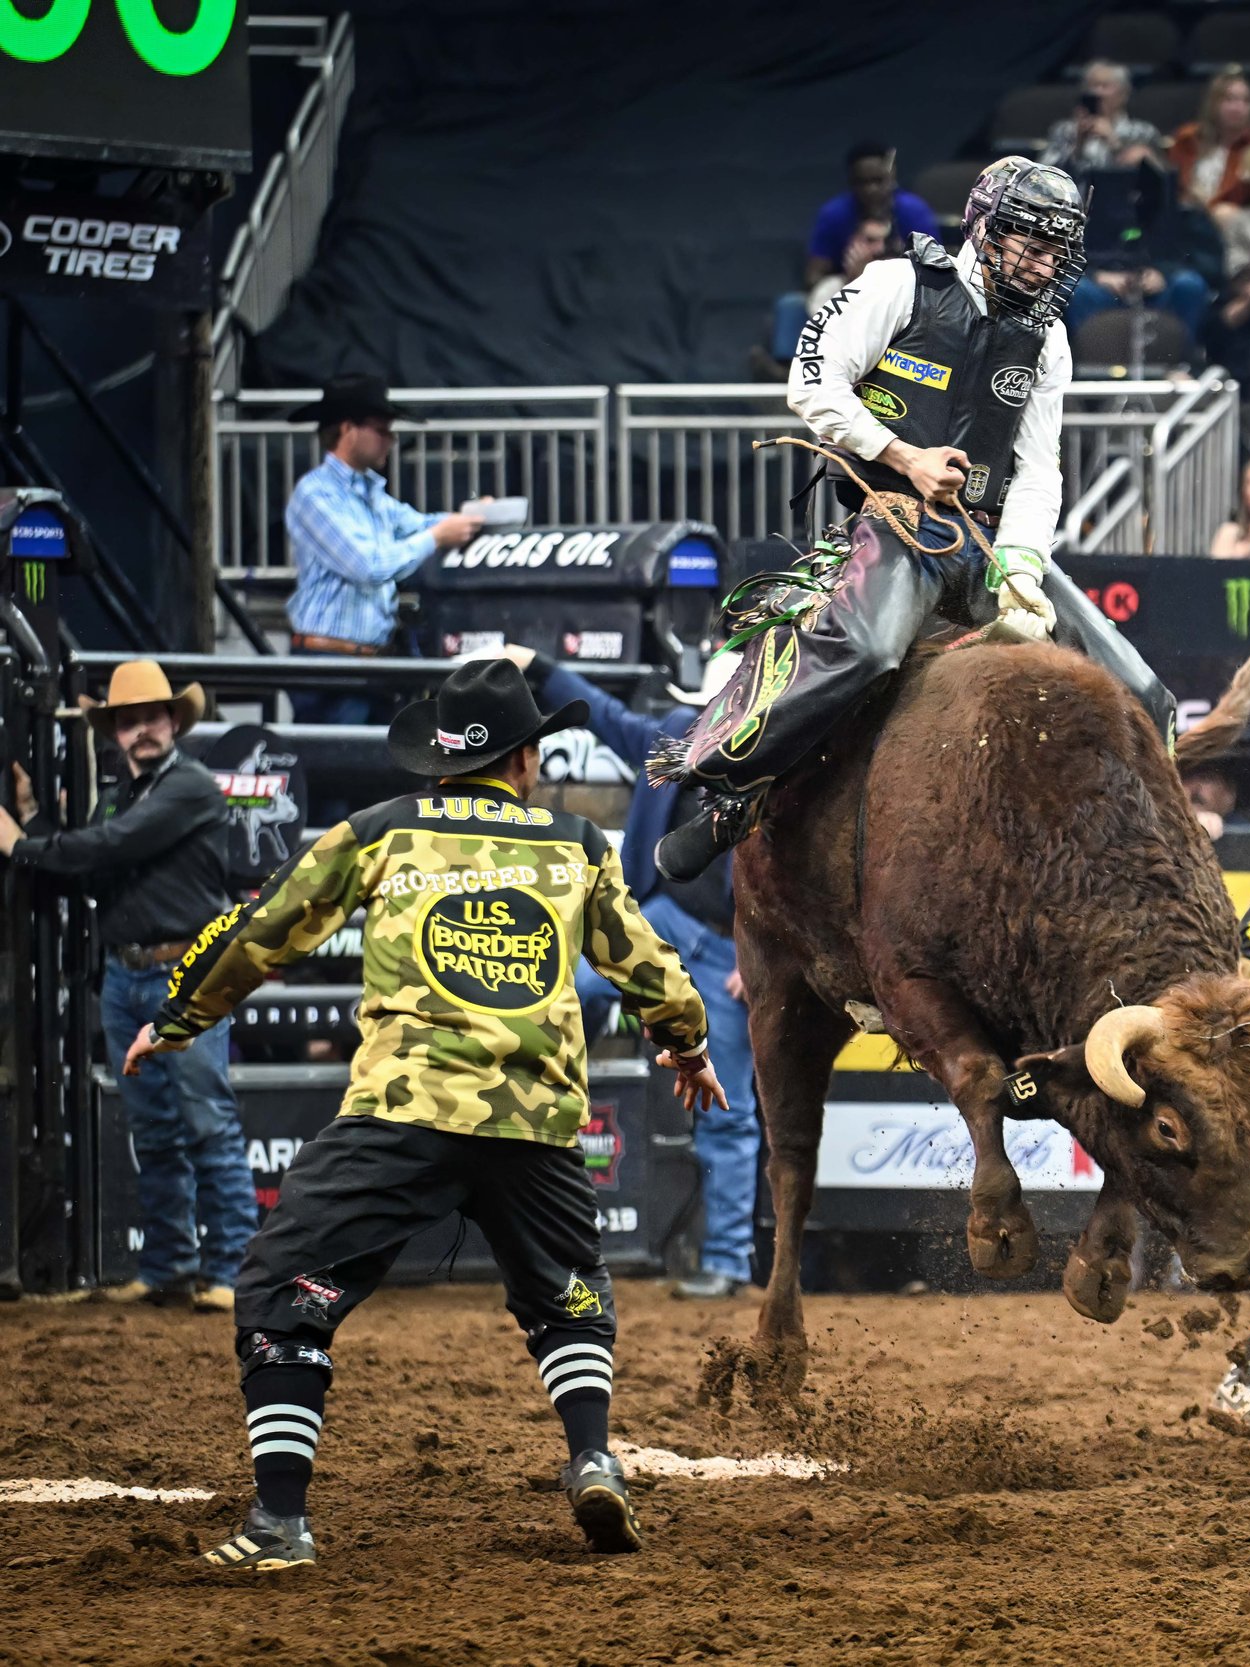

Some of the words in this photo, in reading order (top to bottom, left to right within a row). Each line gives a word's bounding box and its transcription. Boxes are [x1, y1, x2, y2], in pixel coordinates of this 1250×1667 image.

[23, 214, 181, 253] COOPER
[44, 246, 157, 281] TIRES
[796, 288, 861, 386] Wrangler
[885, 351, 947, 382] Wrangler
[442, 533, 565, 569] LUCAS
[555, 532, 620, 567] OIL
[212, 773, 284, 798] PBR
[416, 797, 554, 827] LUCAS
[378, 864, 540, 900] PROTECTED
[546, 862, 588, 887] BY
[464, 901, 516, 926] U.S.
[433, 924, 547, 961] BORDER
[436, 950, 546, 989] PATROL
